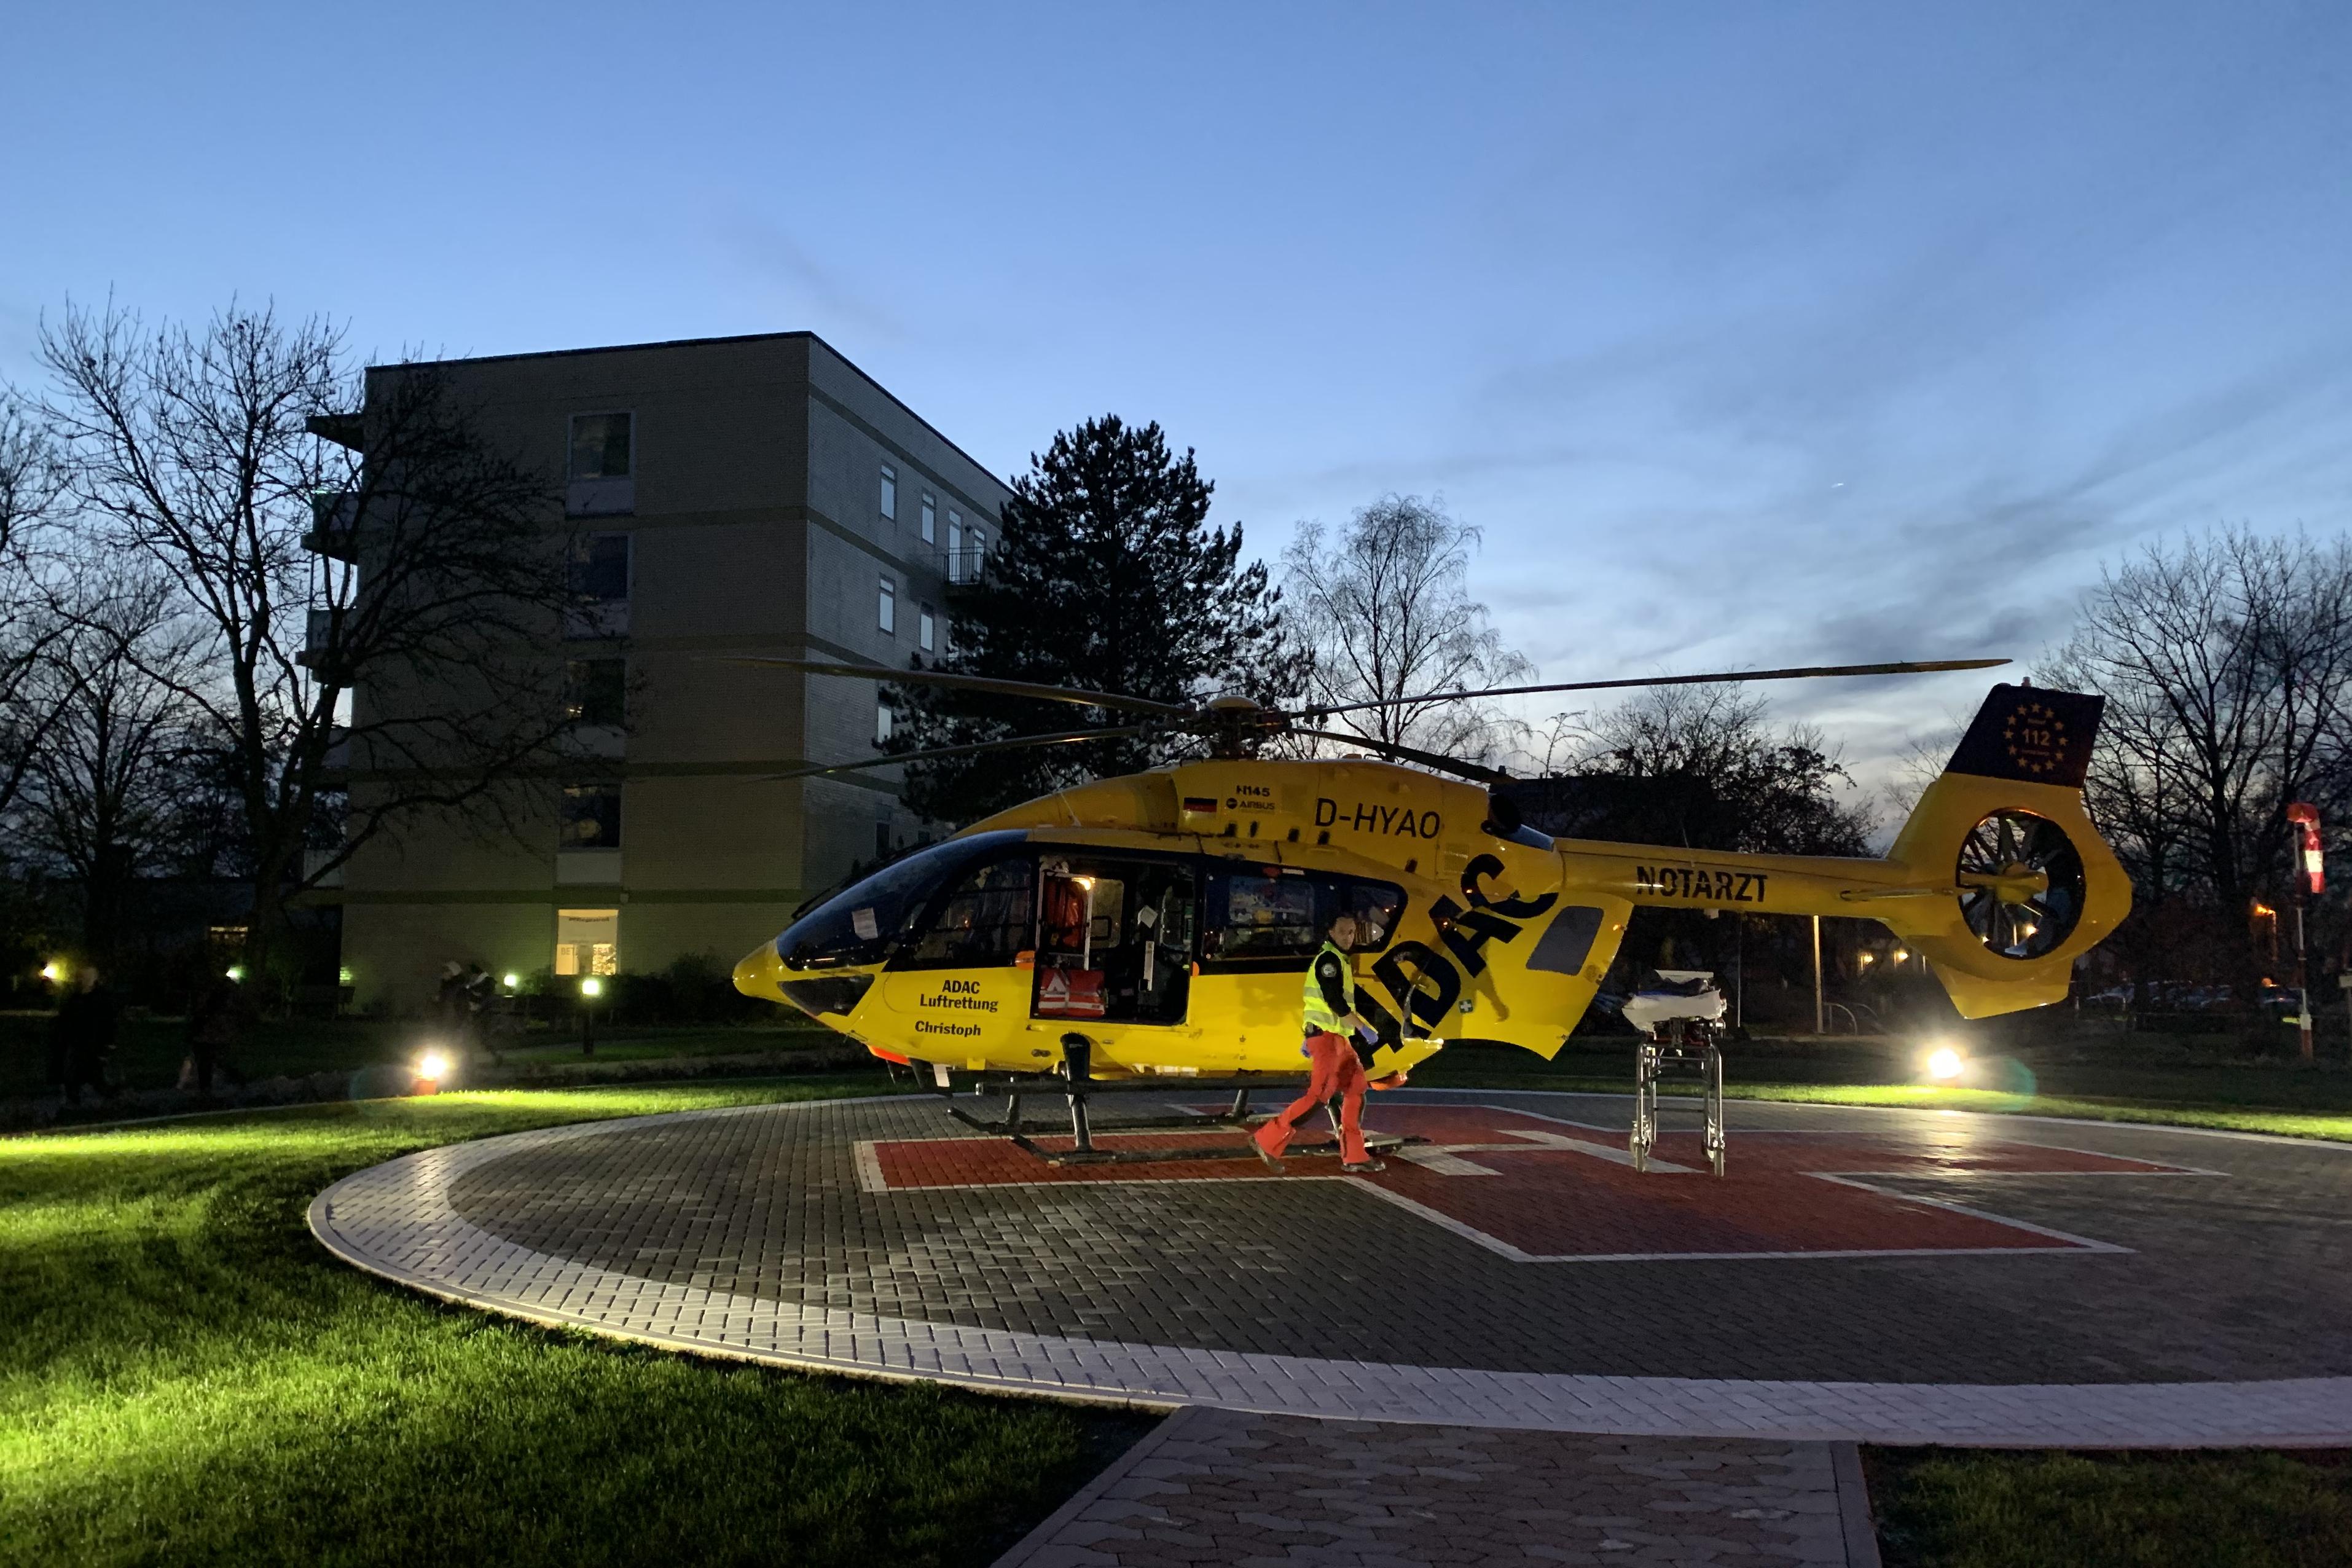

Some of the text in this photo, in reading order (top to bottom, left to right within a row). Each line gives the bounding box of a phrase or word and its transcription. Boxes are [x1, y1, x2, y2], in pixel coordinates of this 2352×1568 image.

[2022, 728, 2050, 747] 112
[1236, 785, 1271, 797] H145
[1239, 800, 1276, 810] AIRBUS
[1314, 797, 1440, 839] D-HYAO
[1636, 865, 1768, 903] NOTARZT
[1347, 853, 1559, 1068] ADAC
[941, 979, 981, 994] ADAC
[919, 993, 999, 1013] Luftrettung
[914, 1020, 982, 1038] Christoph
